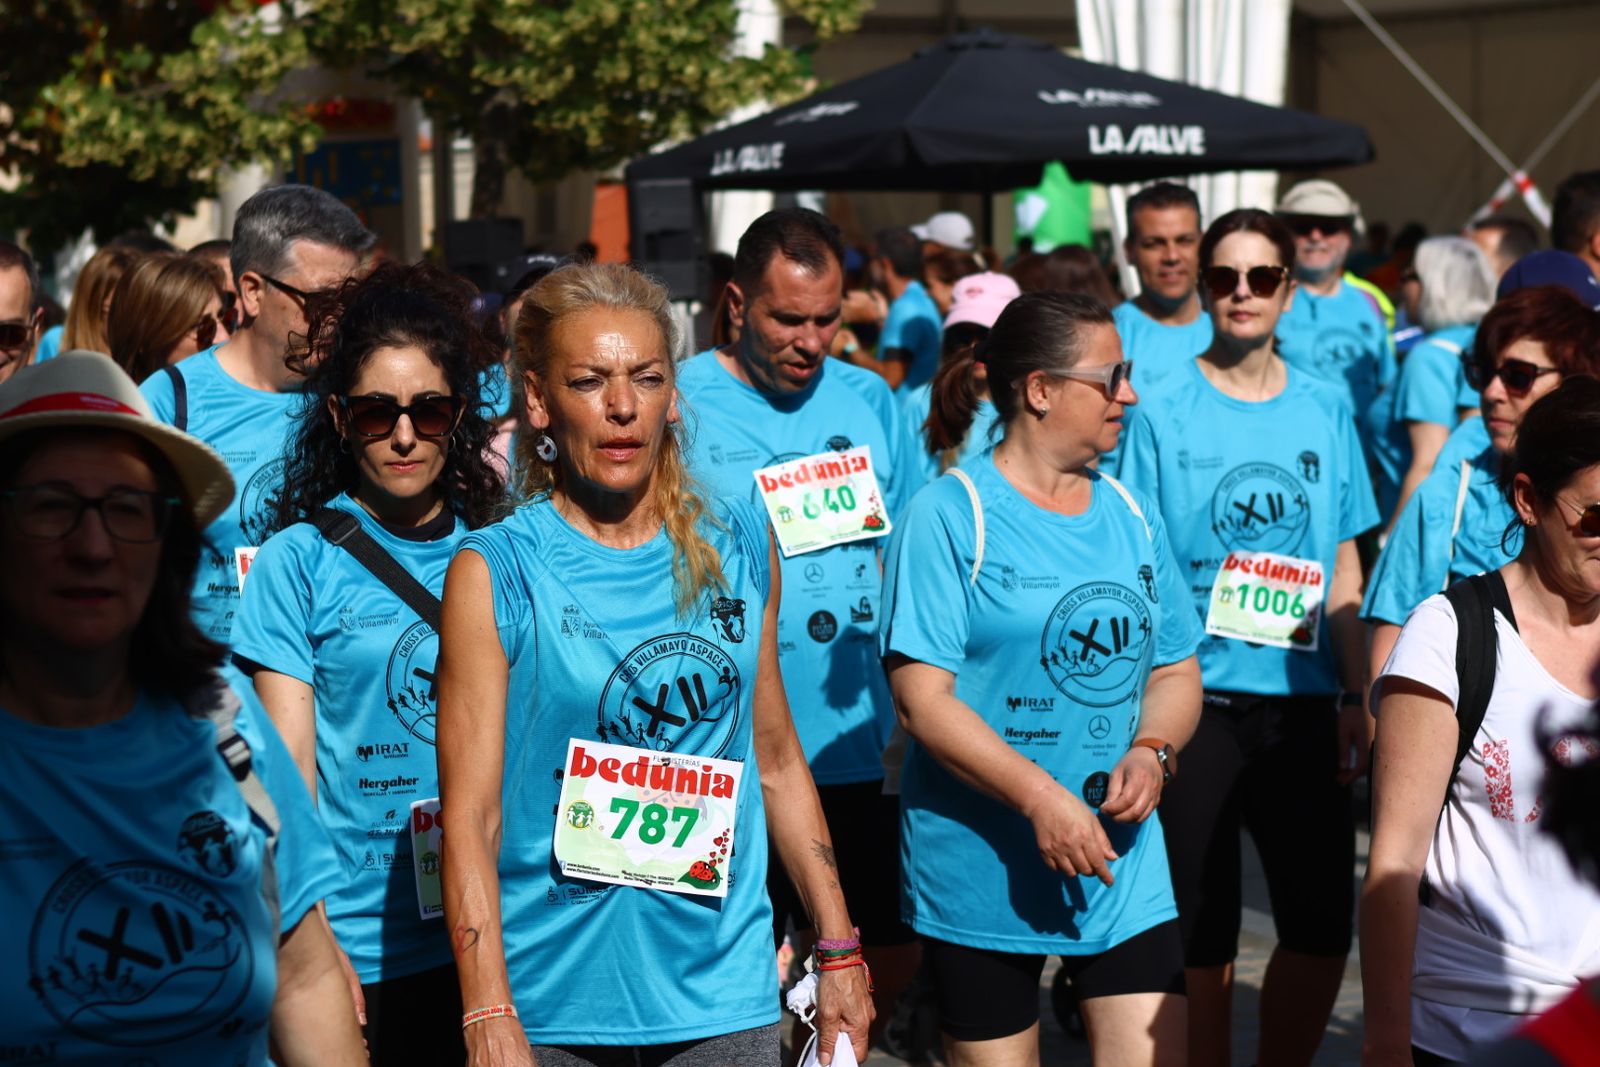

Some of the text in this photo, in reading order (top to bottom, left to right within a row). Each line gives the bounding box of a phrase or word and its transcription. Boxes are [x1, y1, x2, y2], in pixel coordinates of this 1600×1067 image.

[759, 455, 868, 493] bedunia
[802, 485, 856, 519] 640
[1223, 553, 1322, 586] bedunia
[1056, 597, 1078, 621] CROSS
[1076, 587, 1122, 601] VILLAMAYOR
[1237, 583, 1306, 619] 1006
[359, 617, 399, 629] Villamayor
[398, 632, 419, 658] CROSS
[690, 642, 725, 668] ASPACE
[632, 672, 708, 737] XII
[1004, 727, 1061, 742] Hergaher
[359, 775, 419, 791] Hergaher
[570, 747, 735, 798] bedunia
[609, 797, 700, 848] 787
[77, 902, 195, 981] XII
